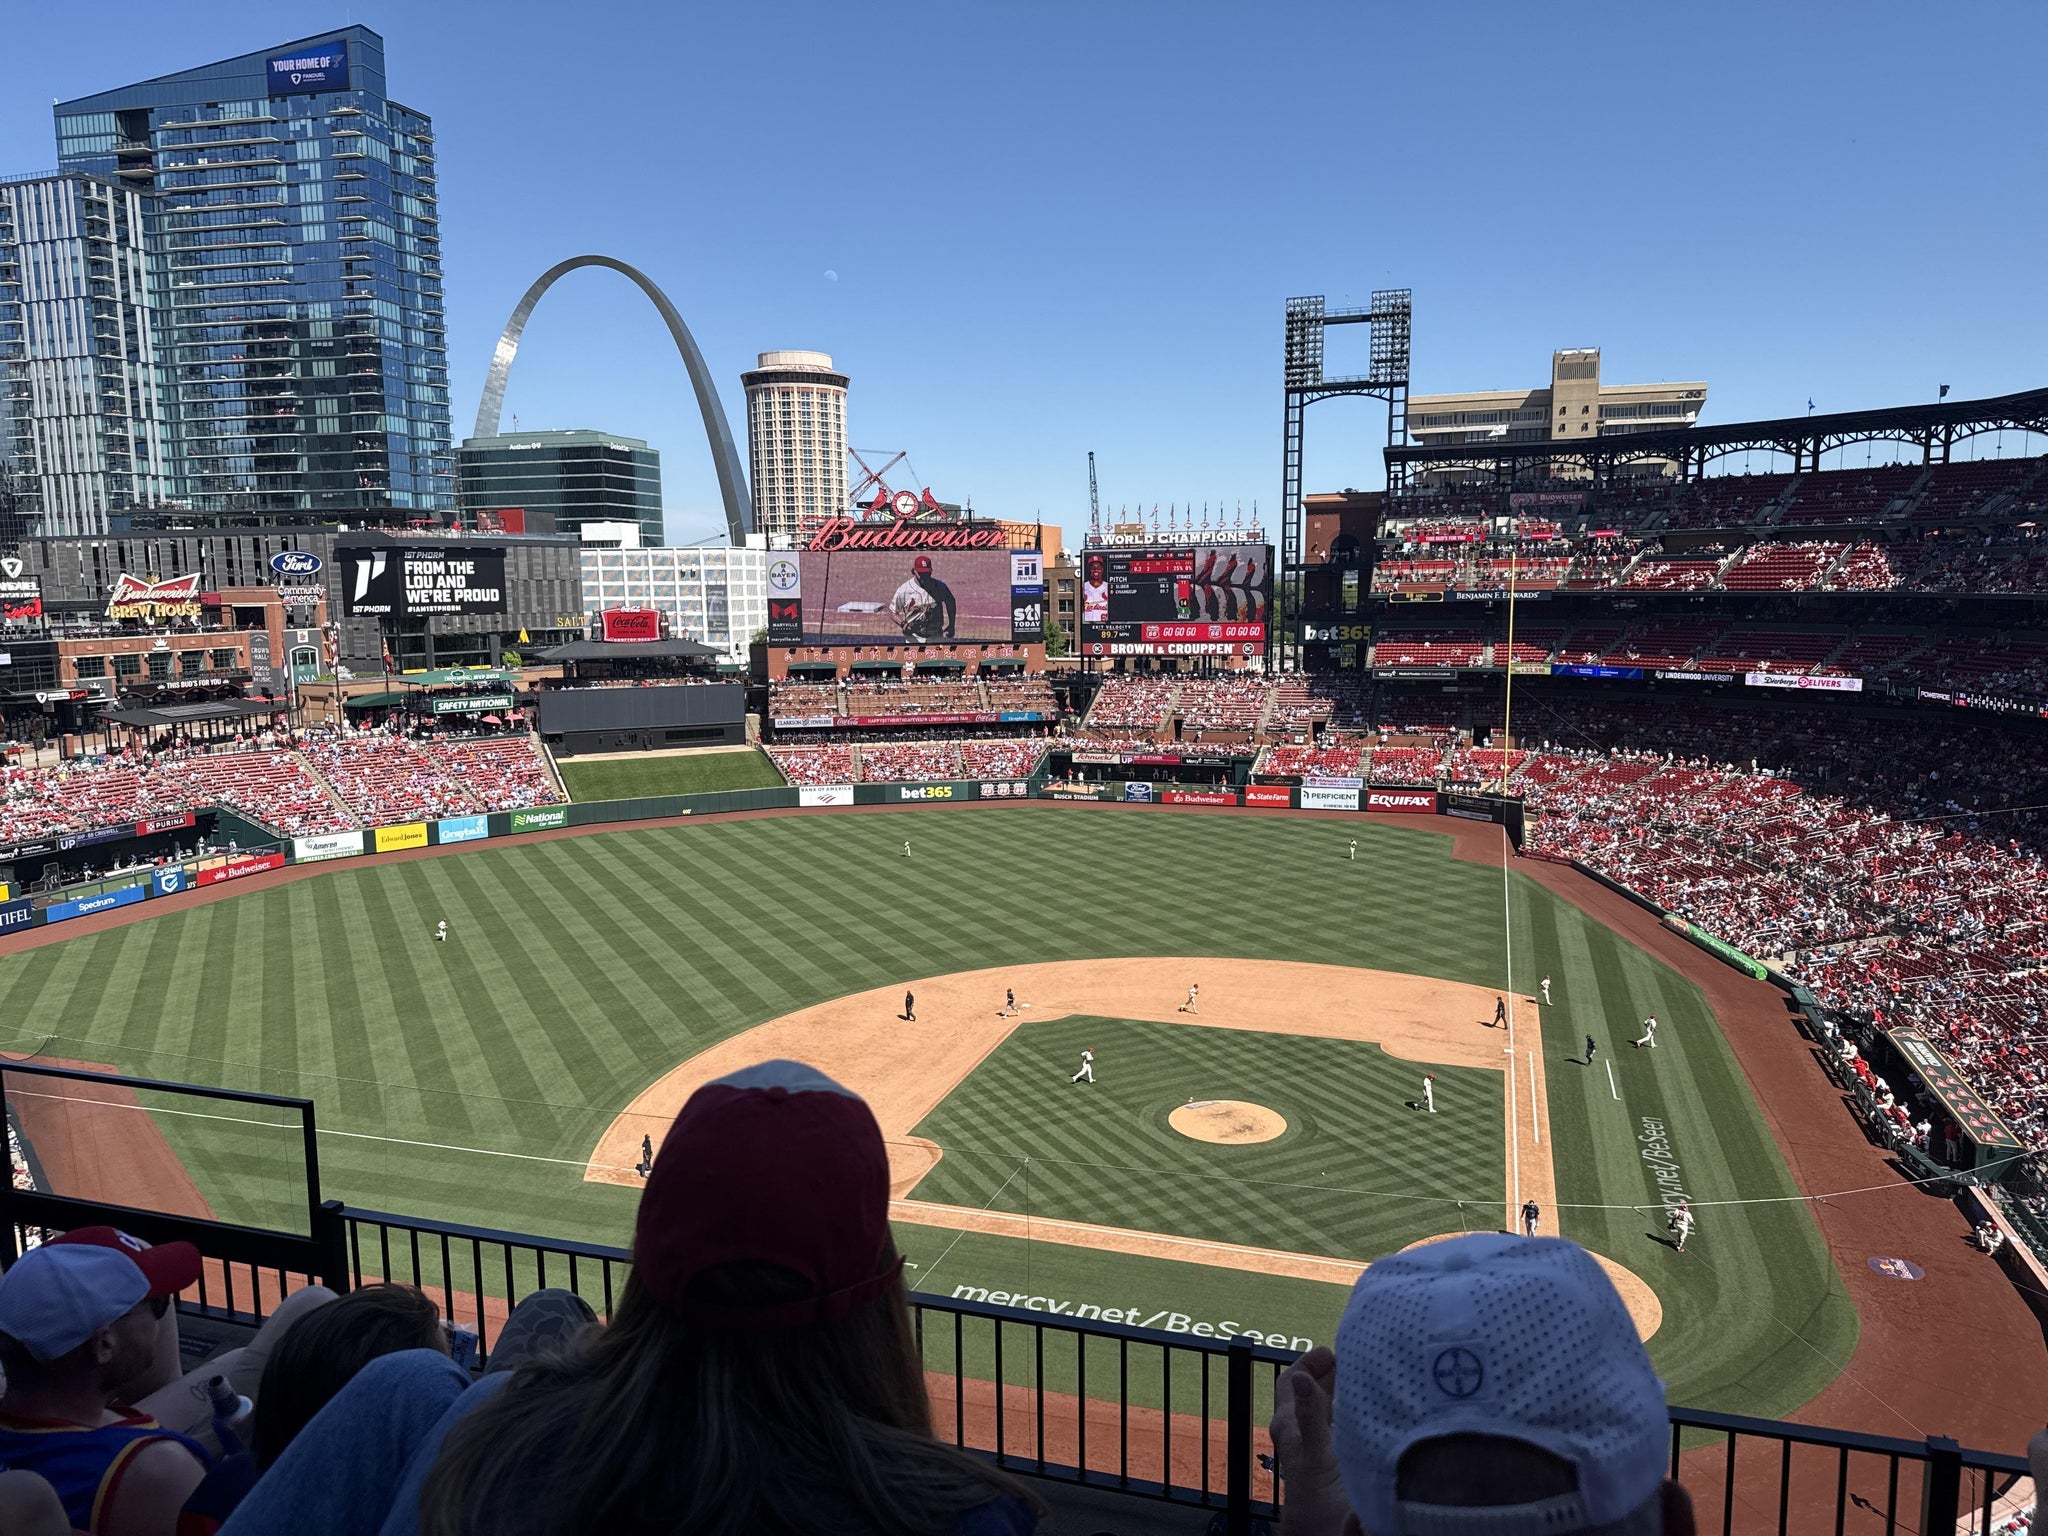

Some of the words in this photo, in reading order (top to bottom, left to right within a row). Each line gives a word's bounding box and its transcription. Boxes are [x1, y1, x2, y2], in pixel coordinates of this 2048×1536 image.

[273, 60, 295, 72] YOUR
[295, 58, 319, 70] HOME
[320, 56, 331, 67] OF
[610, 442, 630, 452] Deloitte
[799, 516, 1009, 552] Budweiser
[1100, 534, 1154, 545] WORLD
[1158, 532, 1248, 544] CHAMPIONS
[417, 551, 445, 559] PHORM
[282, 554, 313, 571] Ford
[405, 561, 447, 575] FROM
[450, 561, 475, 575] THE
[405, 575, 435, 589] LOU
[436, 575, 466, 589] AND
[107, 583, 199, 602] Budweiser
[406, 589, 452, 603] WE'RE
[454, 588, 500, 602] PROUD
[1456, 590, 1493, 600] BENJAMIN
[1494, 590, 1501, 599] F.
[110, 604, 151, 619] BREW
[155, 602, 202, 618] HOUSE
[364, 605, 391, 613] PHORM
[1013, 603, 1041, 621] stl
[557, 617, 586, 627] SALT
[612, 615, 650, 629] Coca-Cola
[1101, 630, 1118, 639] 89.7
[1163, 627, 1174, 637] GO
[1174, 627, 1185, 637] GO
[1186, 627, 1197, 637] GO
[1225, 627, 1236, 637] GO
[1237, 627, 1248, 637] GO
[1249, 626, 1260, 636] GO
[1304, 624, 1372, 641] bet365
[1110, 643, 1154, 654] BROWN
[1157, 645, 1165, 653] &
[1168, 643, 1233, 654] CROUPPEN
[1665, 672, 1702, 681] LINDENWOOD
[1702, 673, 1734, 682] UNIVERSITY
[1764, 675, 1797, 686] Dierbergs
[166, 682, 180, 690] THIS
[180, 680, 198, 689] BUD'S
[198, 679, 210, 688] FOR
[210, 678, 222, 687] YOU
[1920, 690, 1951, 701] POWERADE
[437, 701, 469, 711] SAFETY
[469, 698, 510, 708] NATIONAL
[901, 786, 952, 799] bet365
[1130, 784, 1147, 792] Ford
[1185, 795, 1225, 804] Budweiser
[1256, 793, 1272, 801] State
[1272, 793, 1289, 801] Farm
[1311, 792, 1357, 800] PERFICIENT
[1369, 794, 1431, 808] EQUIFAX
[154, 816, 186, 829] PURINA
[526, 810, 564, 824] National
[380, 833, 403, 843] Edward
[403, 831, 423, 841] Jones
[60, 839, 76, 850] UP
[312, 841, 338, 851] Ameren
[154, 864, 182, 876] CarShield
[227, 861, 271, 877] Budweiser
[78, 897, 115, 912] Spectrum
